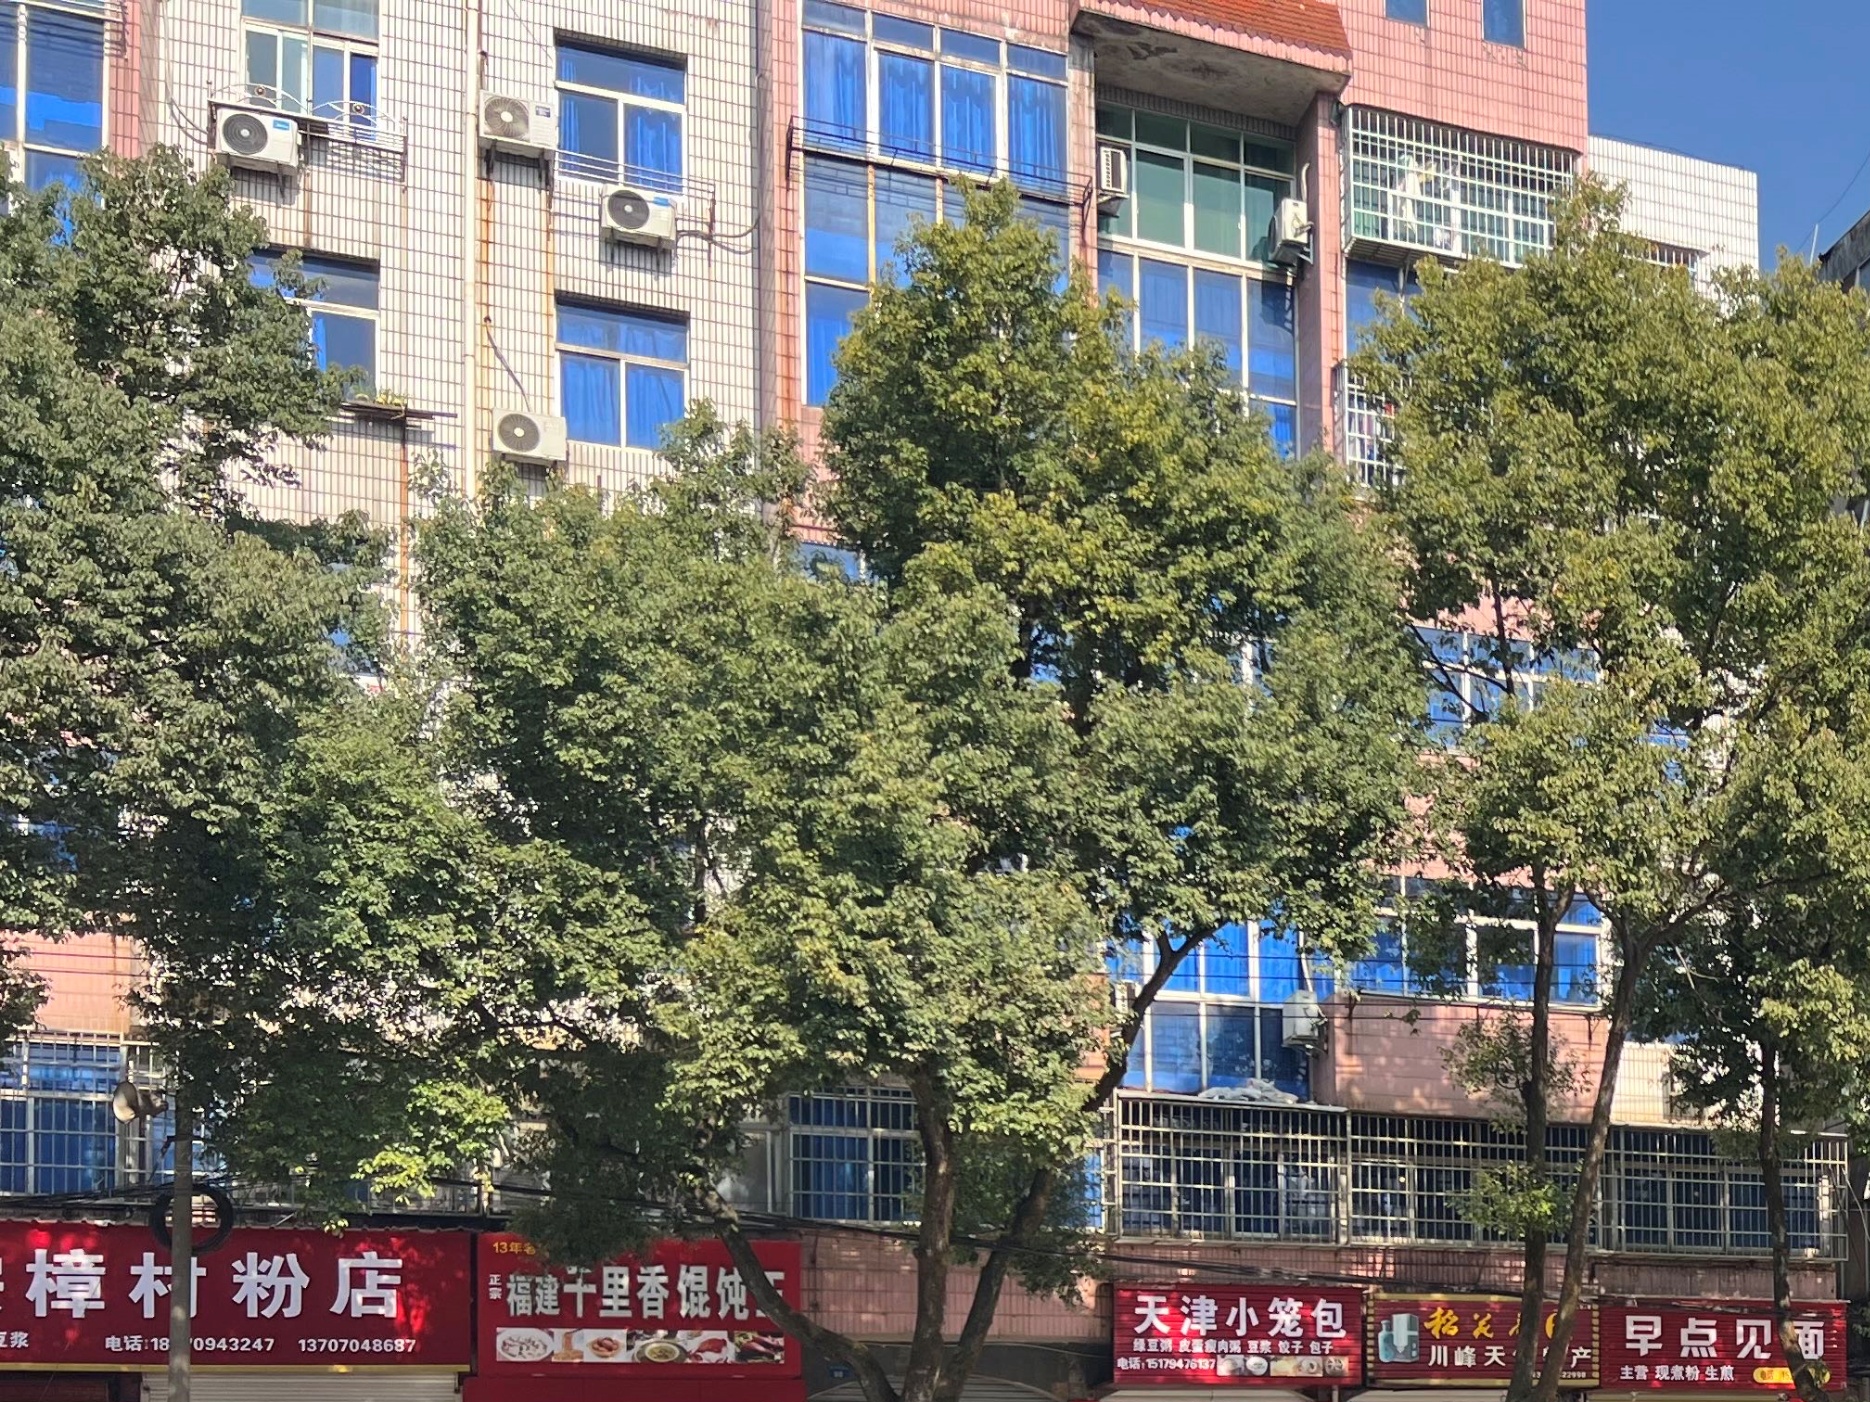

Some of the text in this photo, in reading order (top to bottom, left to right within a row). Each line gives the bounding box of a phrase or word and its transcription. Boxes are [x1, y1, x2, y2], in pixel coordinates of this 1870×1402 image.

[0, 1248, 403, 1319] 樟村粉店
[1133, 1294, 1347, 1338] 天津小笼包
[104, 1335, 416, 1353] 电话:180943247 13707048687
[1624, 1314, 1825, 1360] 早点见面
[1428, 1344, 1592, 1369] 川峰天产
[1619, 1365, 1649, 1381] 主营
[1654, 1364, 1700, 1382] 现煮粉
